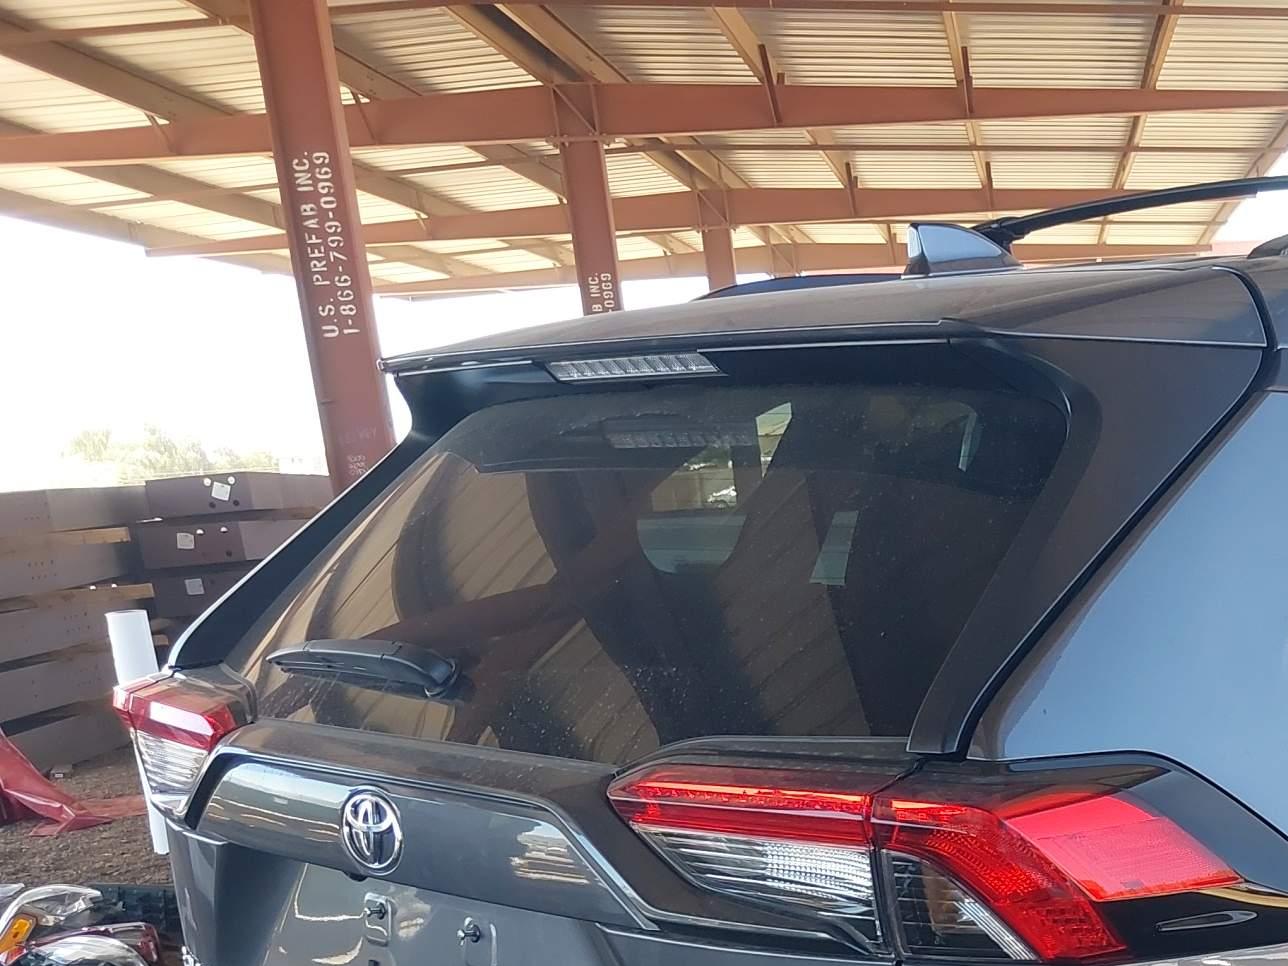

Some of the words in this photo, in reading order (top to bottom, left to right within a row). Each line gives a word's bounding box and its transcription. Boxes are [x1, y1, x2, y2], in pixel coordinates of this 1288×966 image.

[292, 151, 314, 192] INC.
[300, 203, 330, 286] PREFAB
[312, 151, 360, 335] 1-866-799-0969
[588, 272, 601, 297] INC.
[318, 297, 339, 338] U.S.
